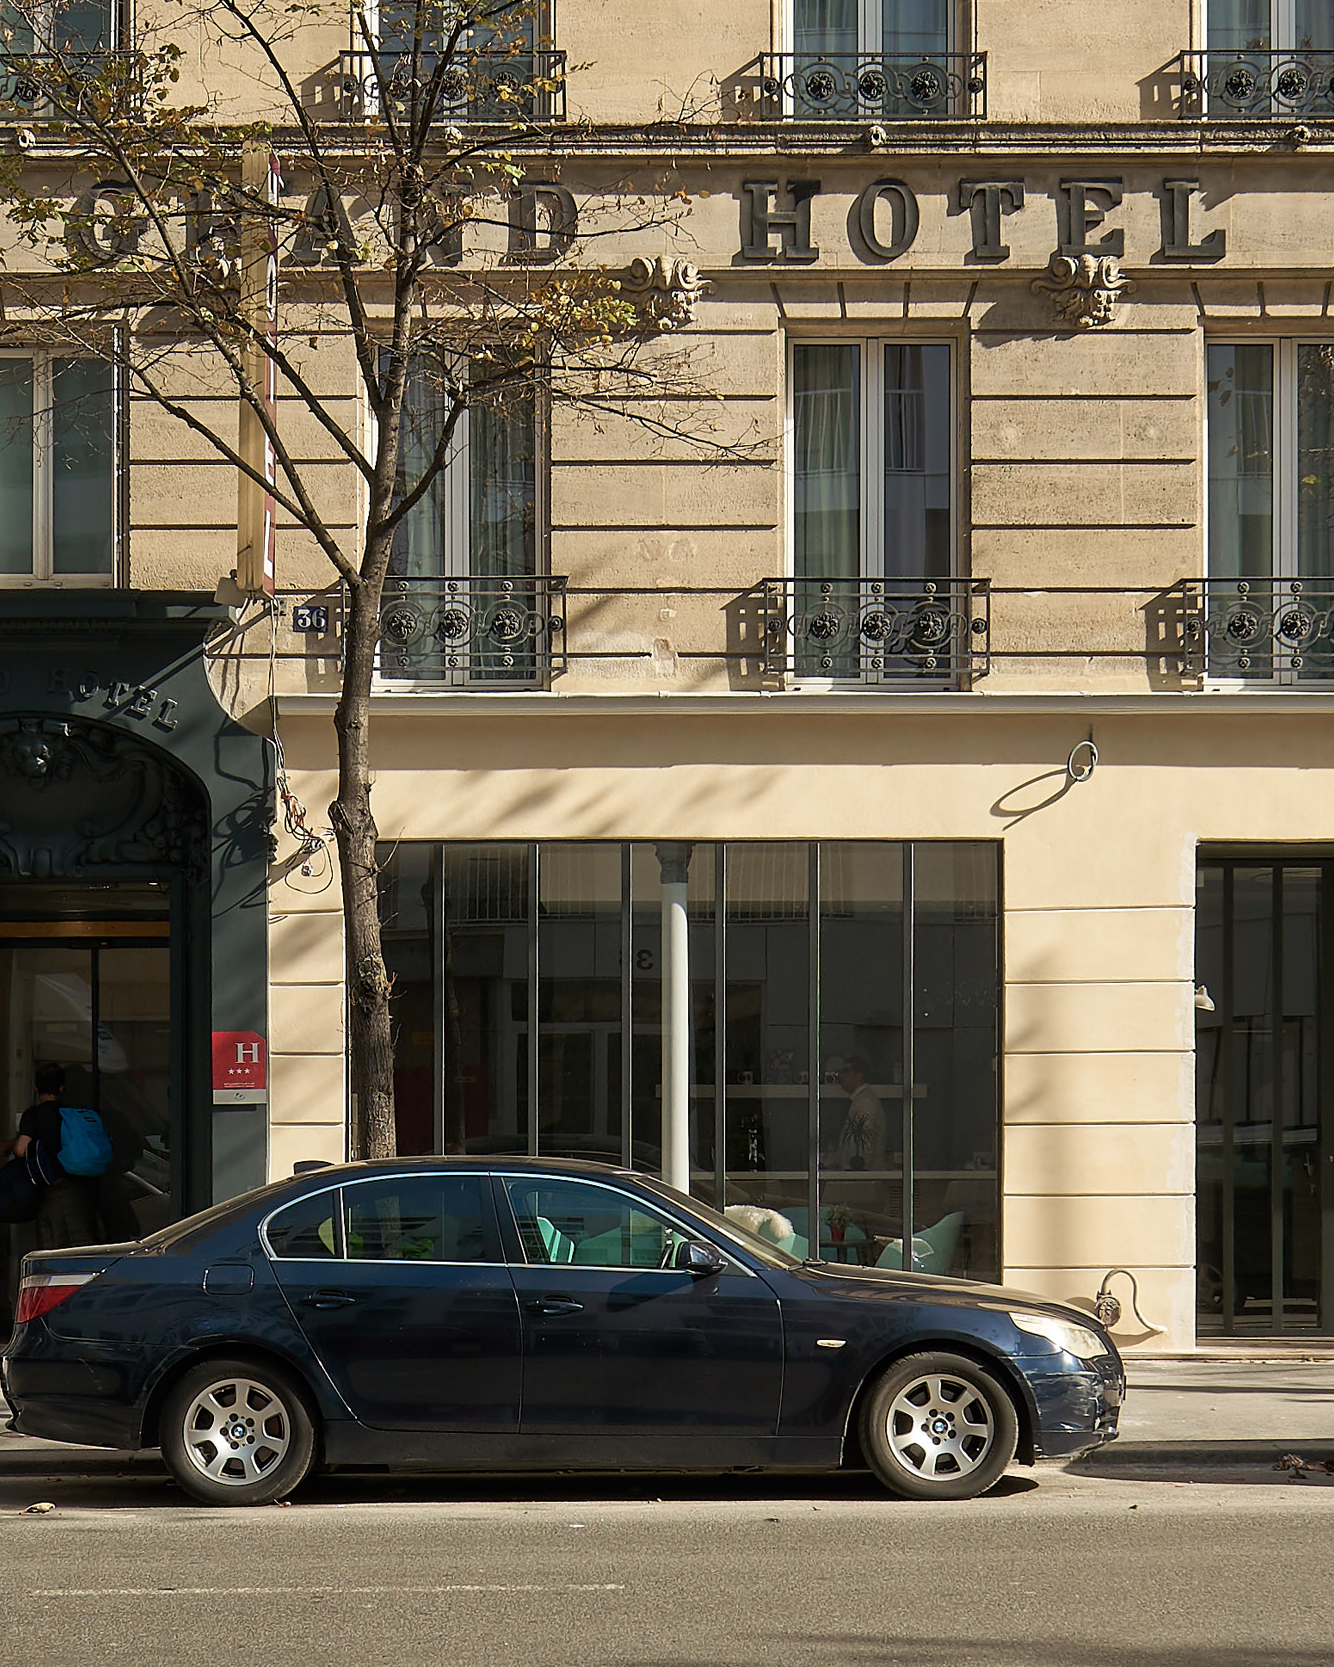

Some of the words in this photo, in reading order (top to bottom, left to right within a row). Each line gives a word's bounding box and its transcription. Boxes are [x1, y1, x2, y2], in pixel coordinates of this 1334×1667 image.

[741, 177, 1227, 265] HOTEL
[297, 607, 326, 629] 36
[45, 665, 180, 733] HOTEL
[234, 1042, 260, 1064] H
